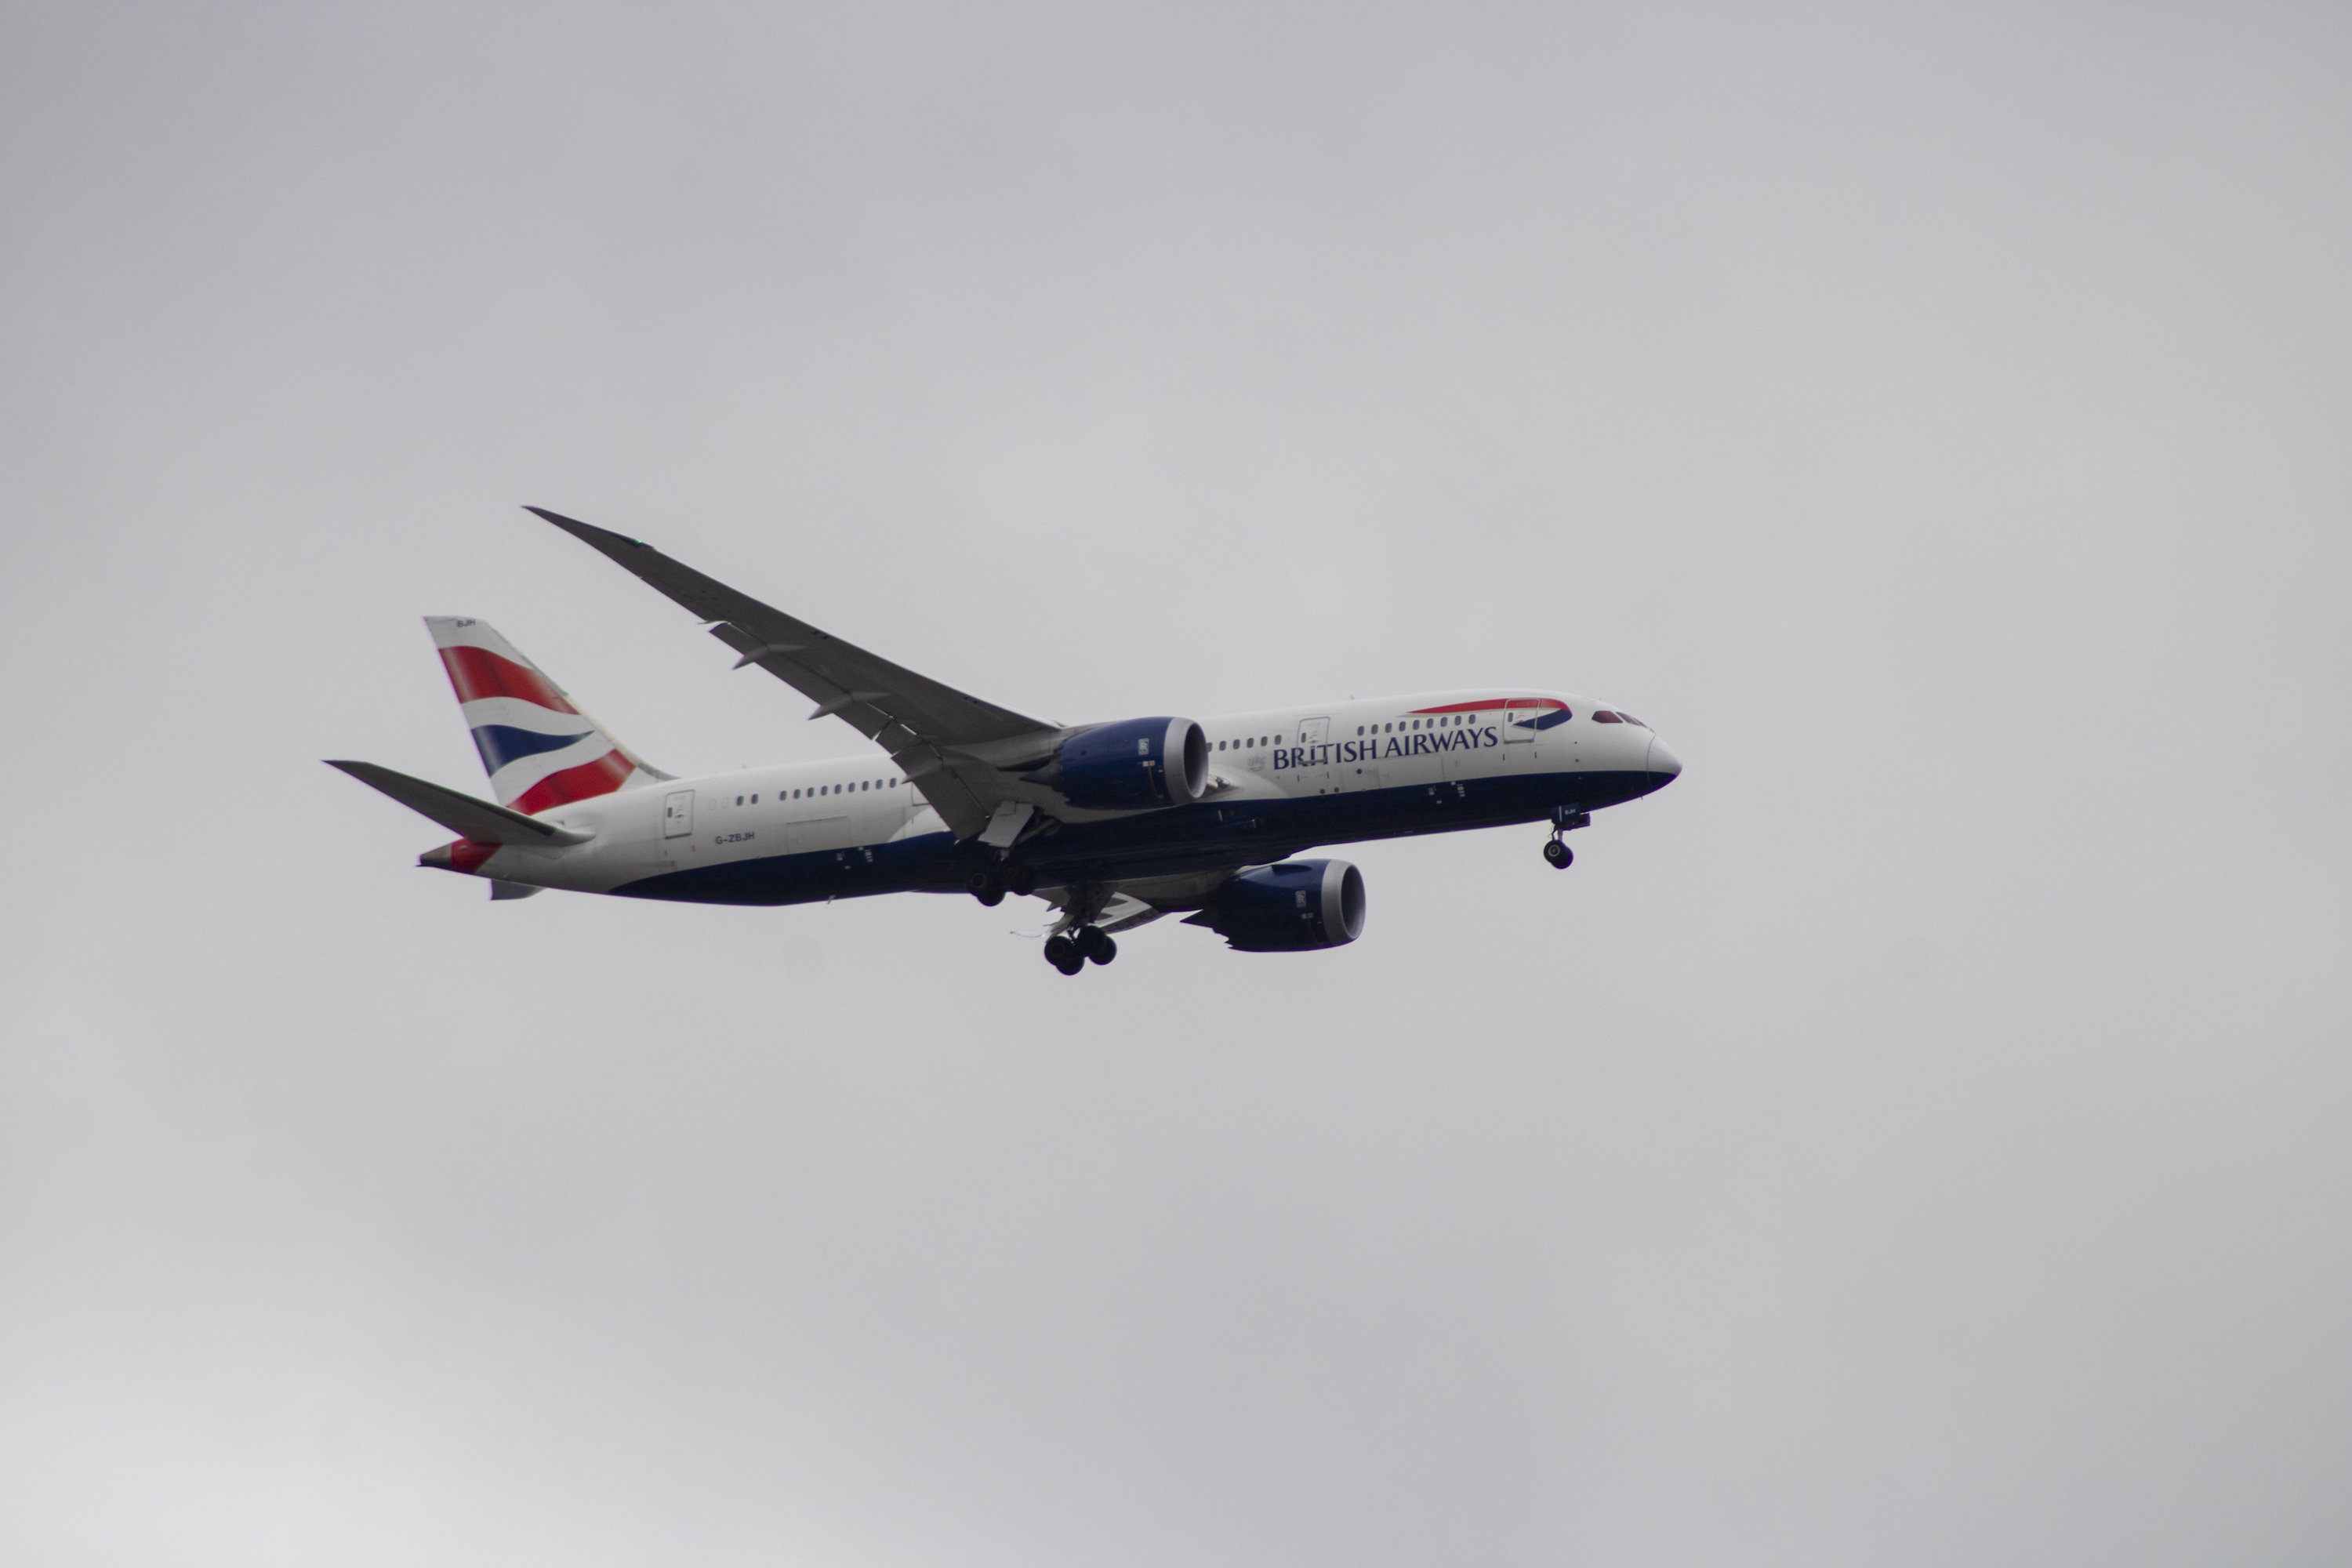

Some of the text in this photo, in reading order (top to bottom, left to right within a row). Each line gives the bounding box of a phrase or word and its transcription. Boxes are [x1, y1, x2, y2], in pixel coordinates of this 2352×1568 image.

[457, 619, 476, 627] BJH
[1273, 726, 1498, 770] BRITISH AIRWAYS
[715, 832, 755, 844] G-ZBJH
